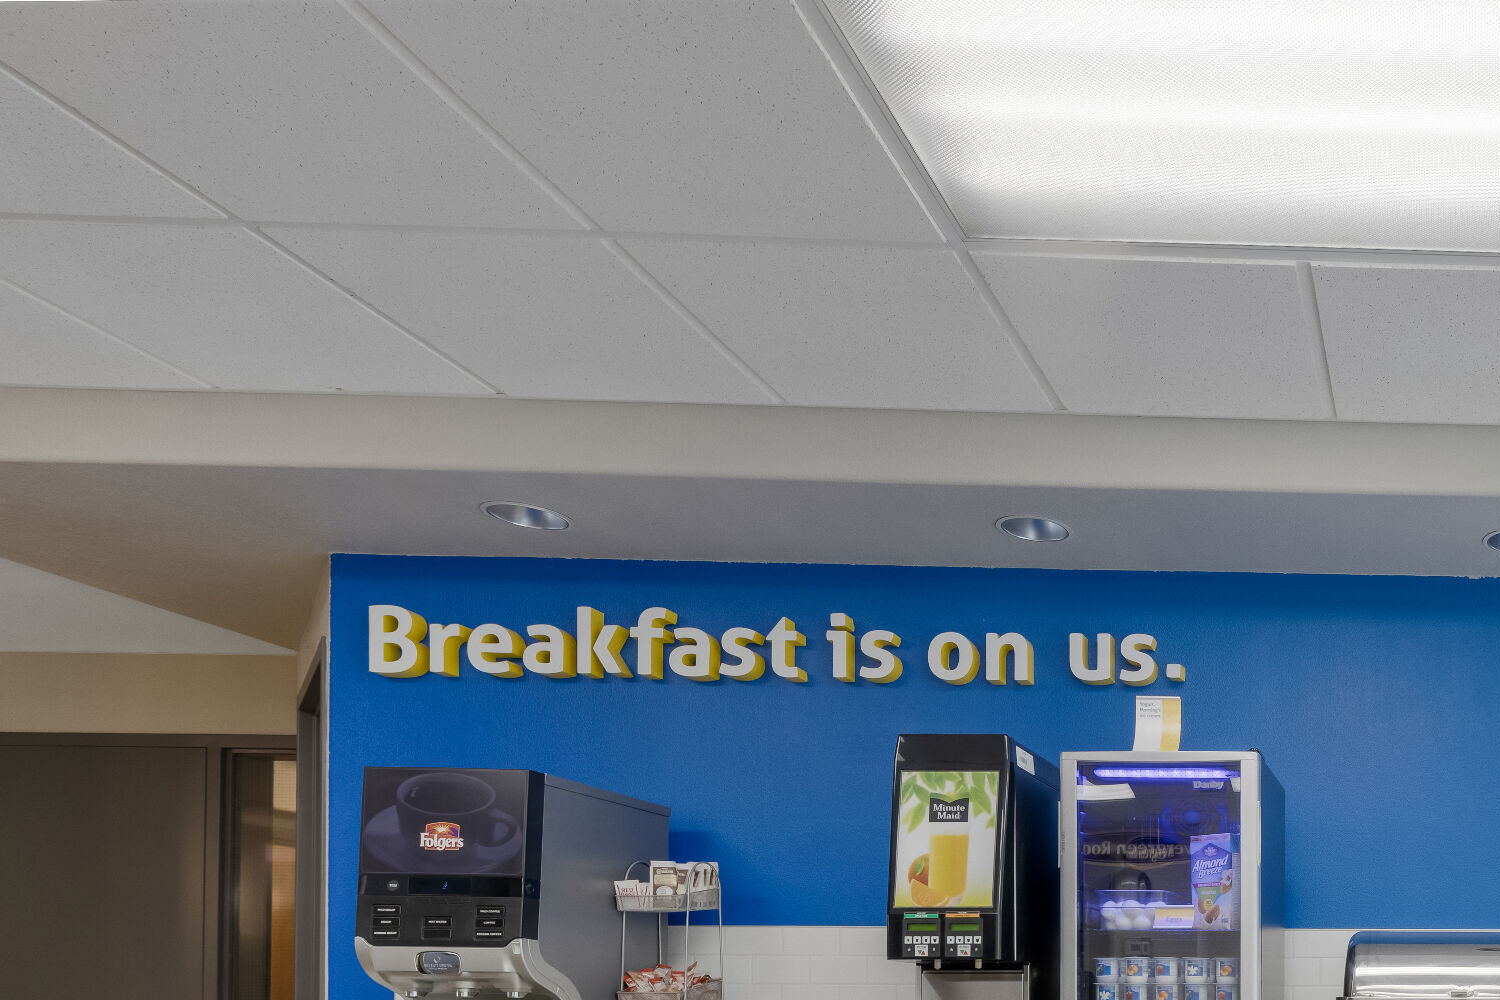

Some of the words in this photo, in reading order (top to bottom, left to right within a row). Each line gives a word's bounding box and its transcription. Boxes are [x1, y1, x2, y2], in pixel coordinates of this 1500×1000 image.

[368, 603, 808, 683] Breakfast
[825, 612, 904, 684] is
[927, 631, 1035, 686] on
[1069, 632, 1186, 687] us.
[932, 803, 966, 812] Minute
[936, 811, 960, 820] Maid
[420, 832, 465, 851] Folgers
[1192, 854, 1229, 873] Almond
[1198, 866, 1223, 878] Breeze
